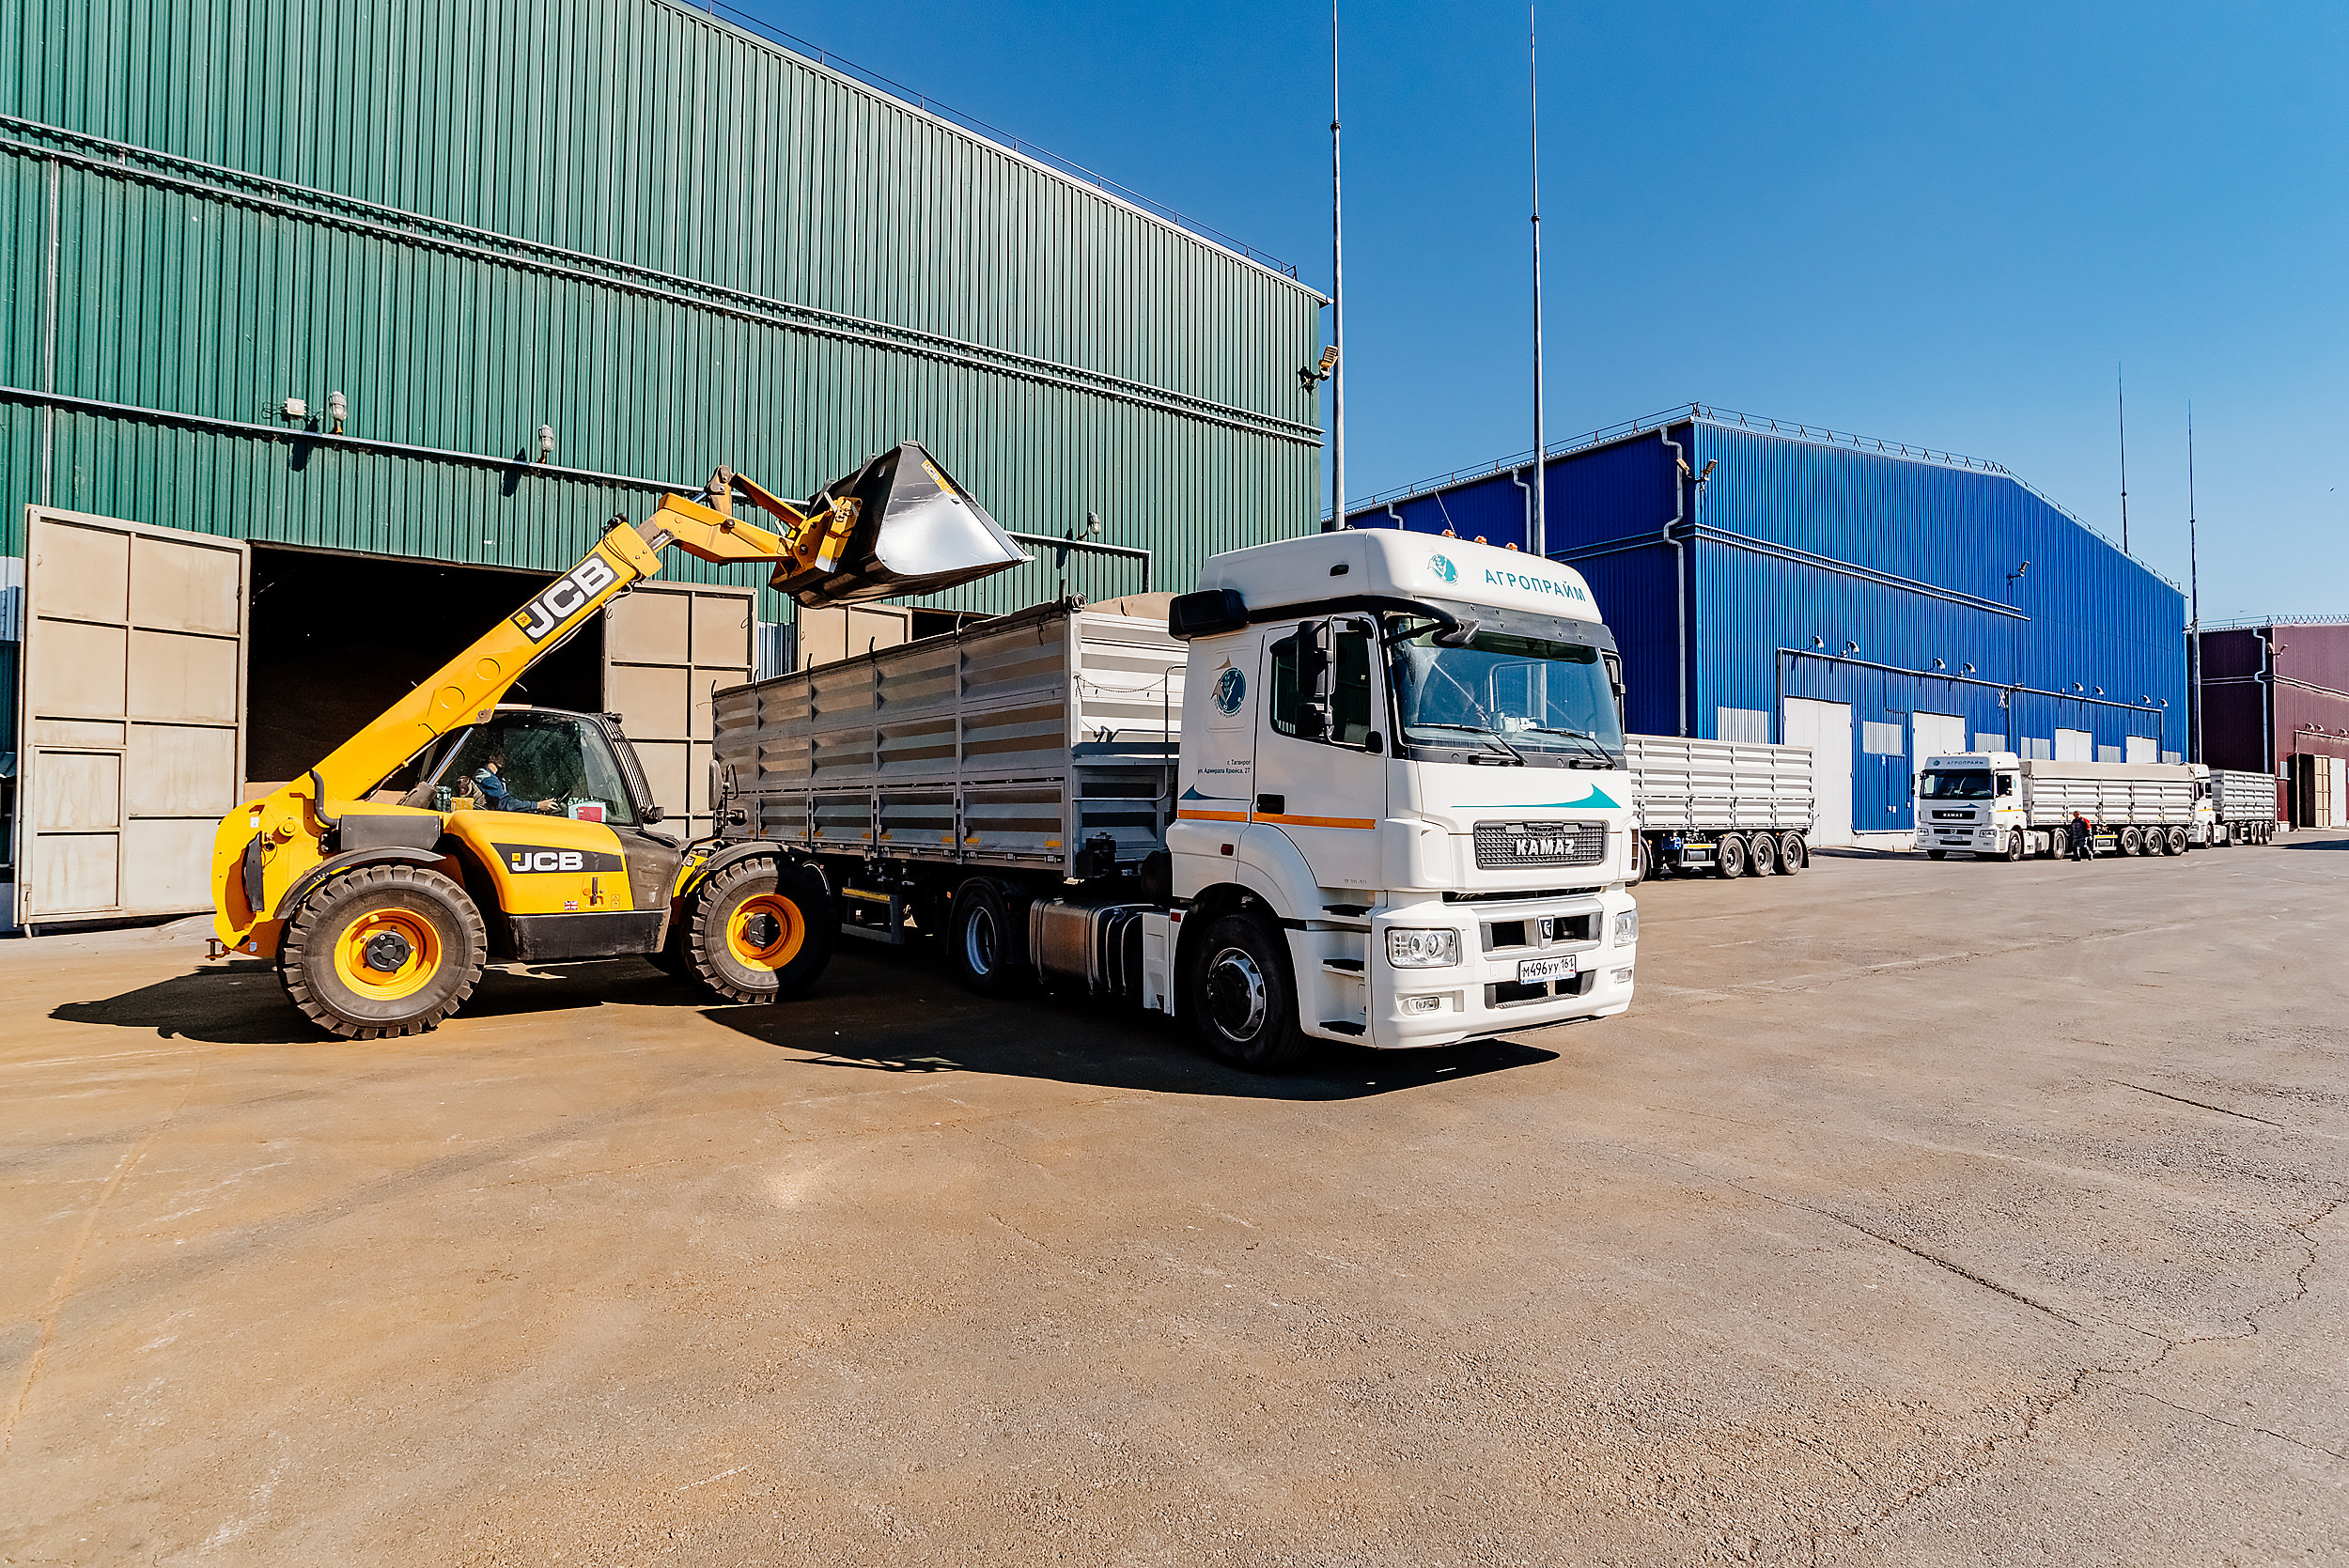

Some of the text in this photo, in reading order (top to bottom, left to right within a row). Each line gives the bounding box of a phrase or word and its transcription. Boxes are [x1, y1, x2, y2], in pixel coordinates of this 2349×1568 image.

[924, 463, 941, 481] JCB
[1485, 568, 1587, 602] АГРОПРАЙМ
[526, 557, 614, 639] JCB
[1515, 838, 1576, 856] KAMAZ
[511, 851, 583, 872] JCB
[1560, 957, 1575, 970] 161
